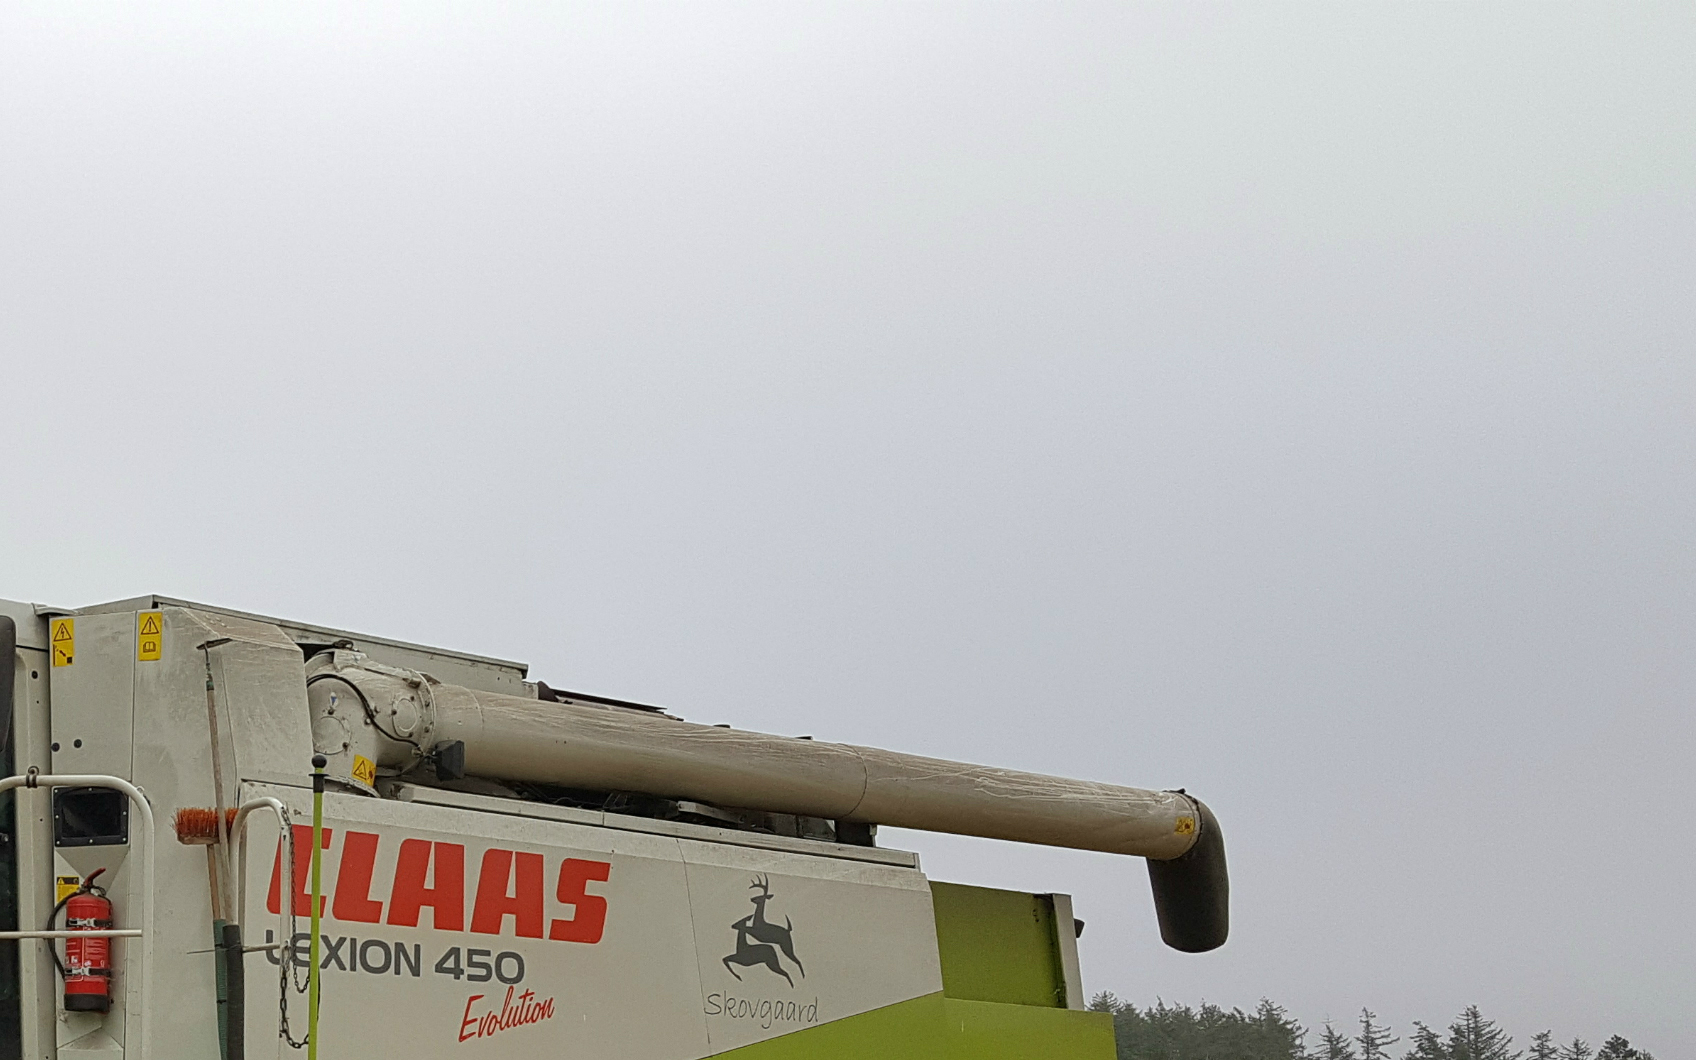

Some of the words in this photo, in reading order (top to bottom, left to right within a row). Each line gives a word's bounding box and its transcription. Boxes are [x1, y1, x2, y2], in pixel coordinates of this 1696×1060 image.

[266, 823, 611, 945] CLAAS
[265, 929, 421, 978] LEXION
[434, 946, 525, 985] 450
[458, 985, 555, 1043] Evolution
[703, 989, 819, 1030] Skovgaard
